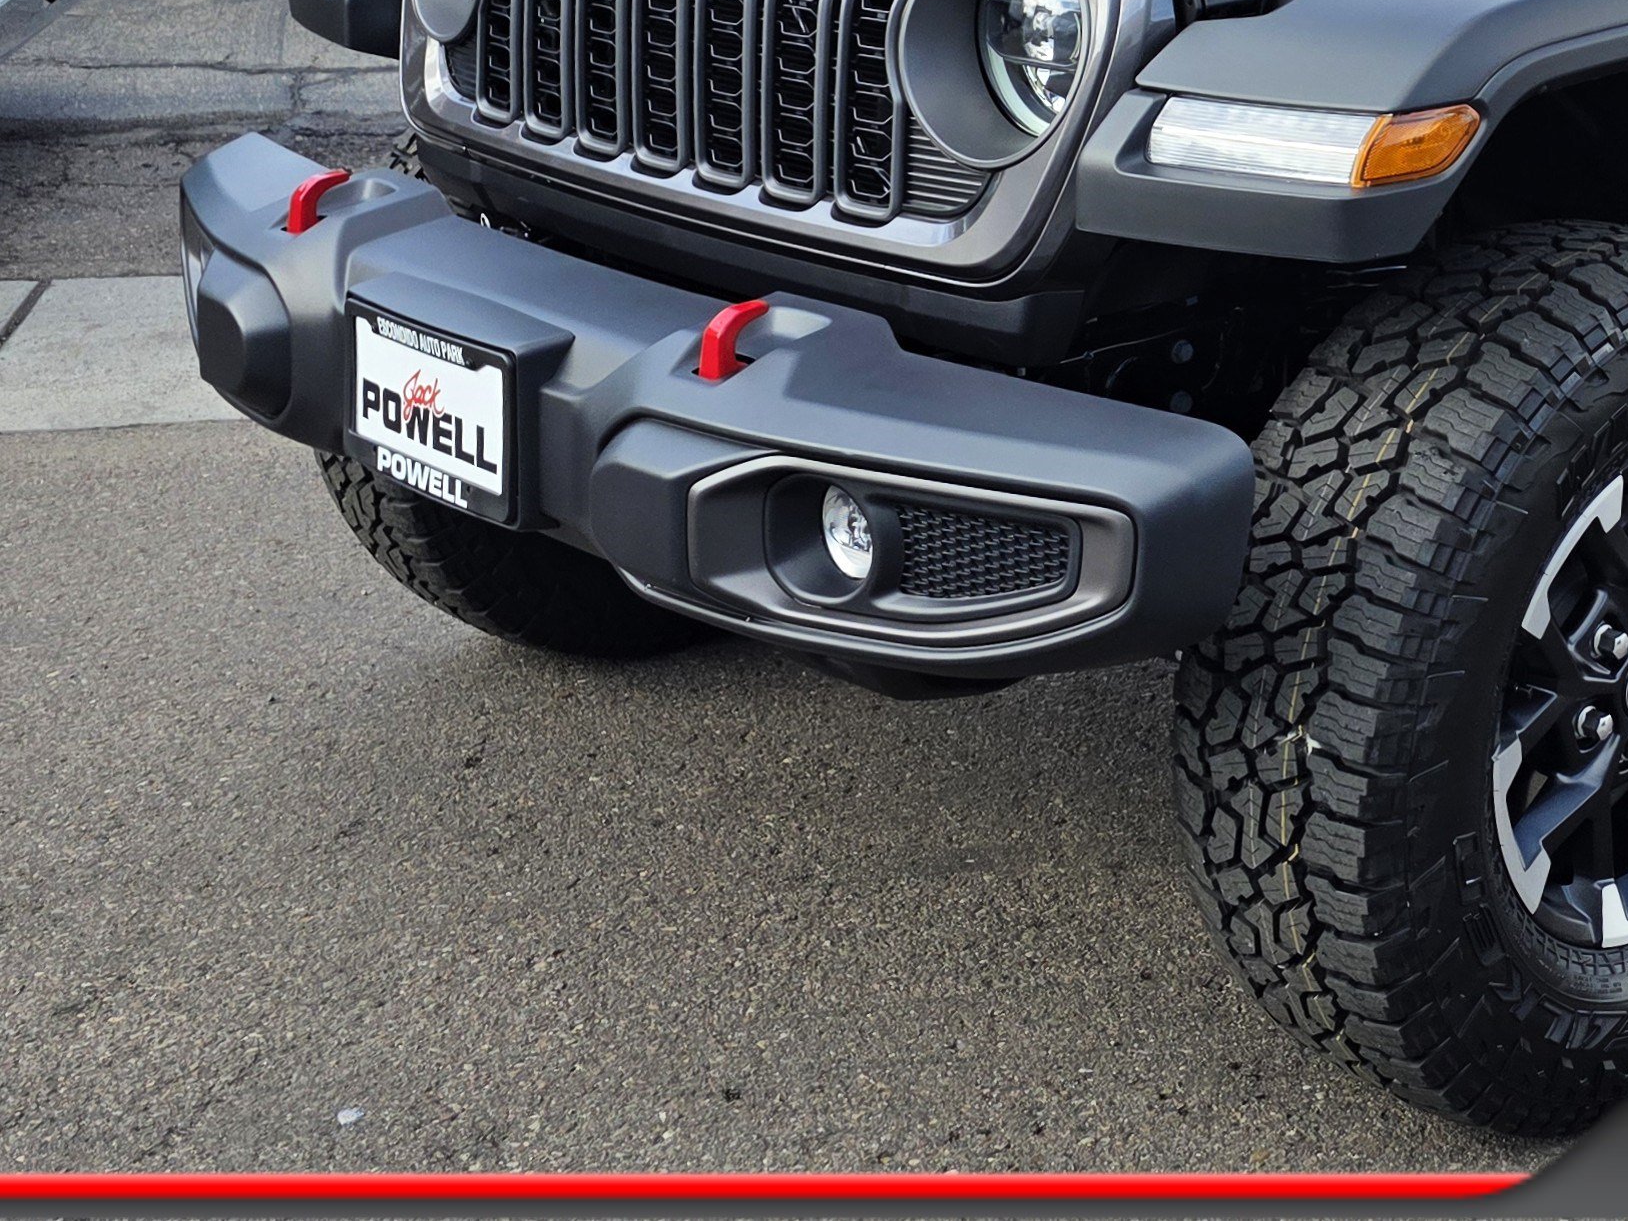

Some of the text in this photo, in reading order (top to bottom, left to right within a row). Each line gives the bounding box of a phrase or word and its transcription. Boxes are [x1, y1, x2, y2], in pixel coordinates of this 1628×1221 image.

[377, 316, 465, 366] ESCONDIDO AUTO PARK
[403, 369, 444, 421] Jack
[363, 377, 497, 476] POWELL
[377, 446, 468, 509] POWELL
